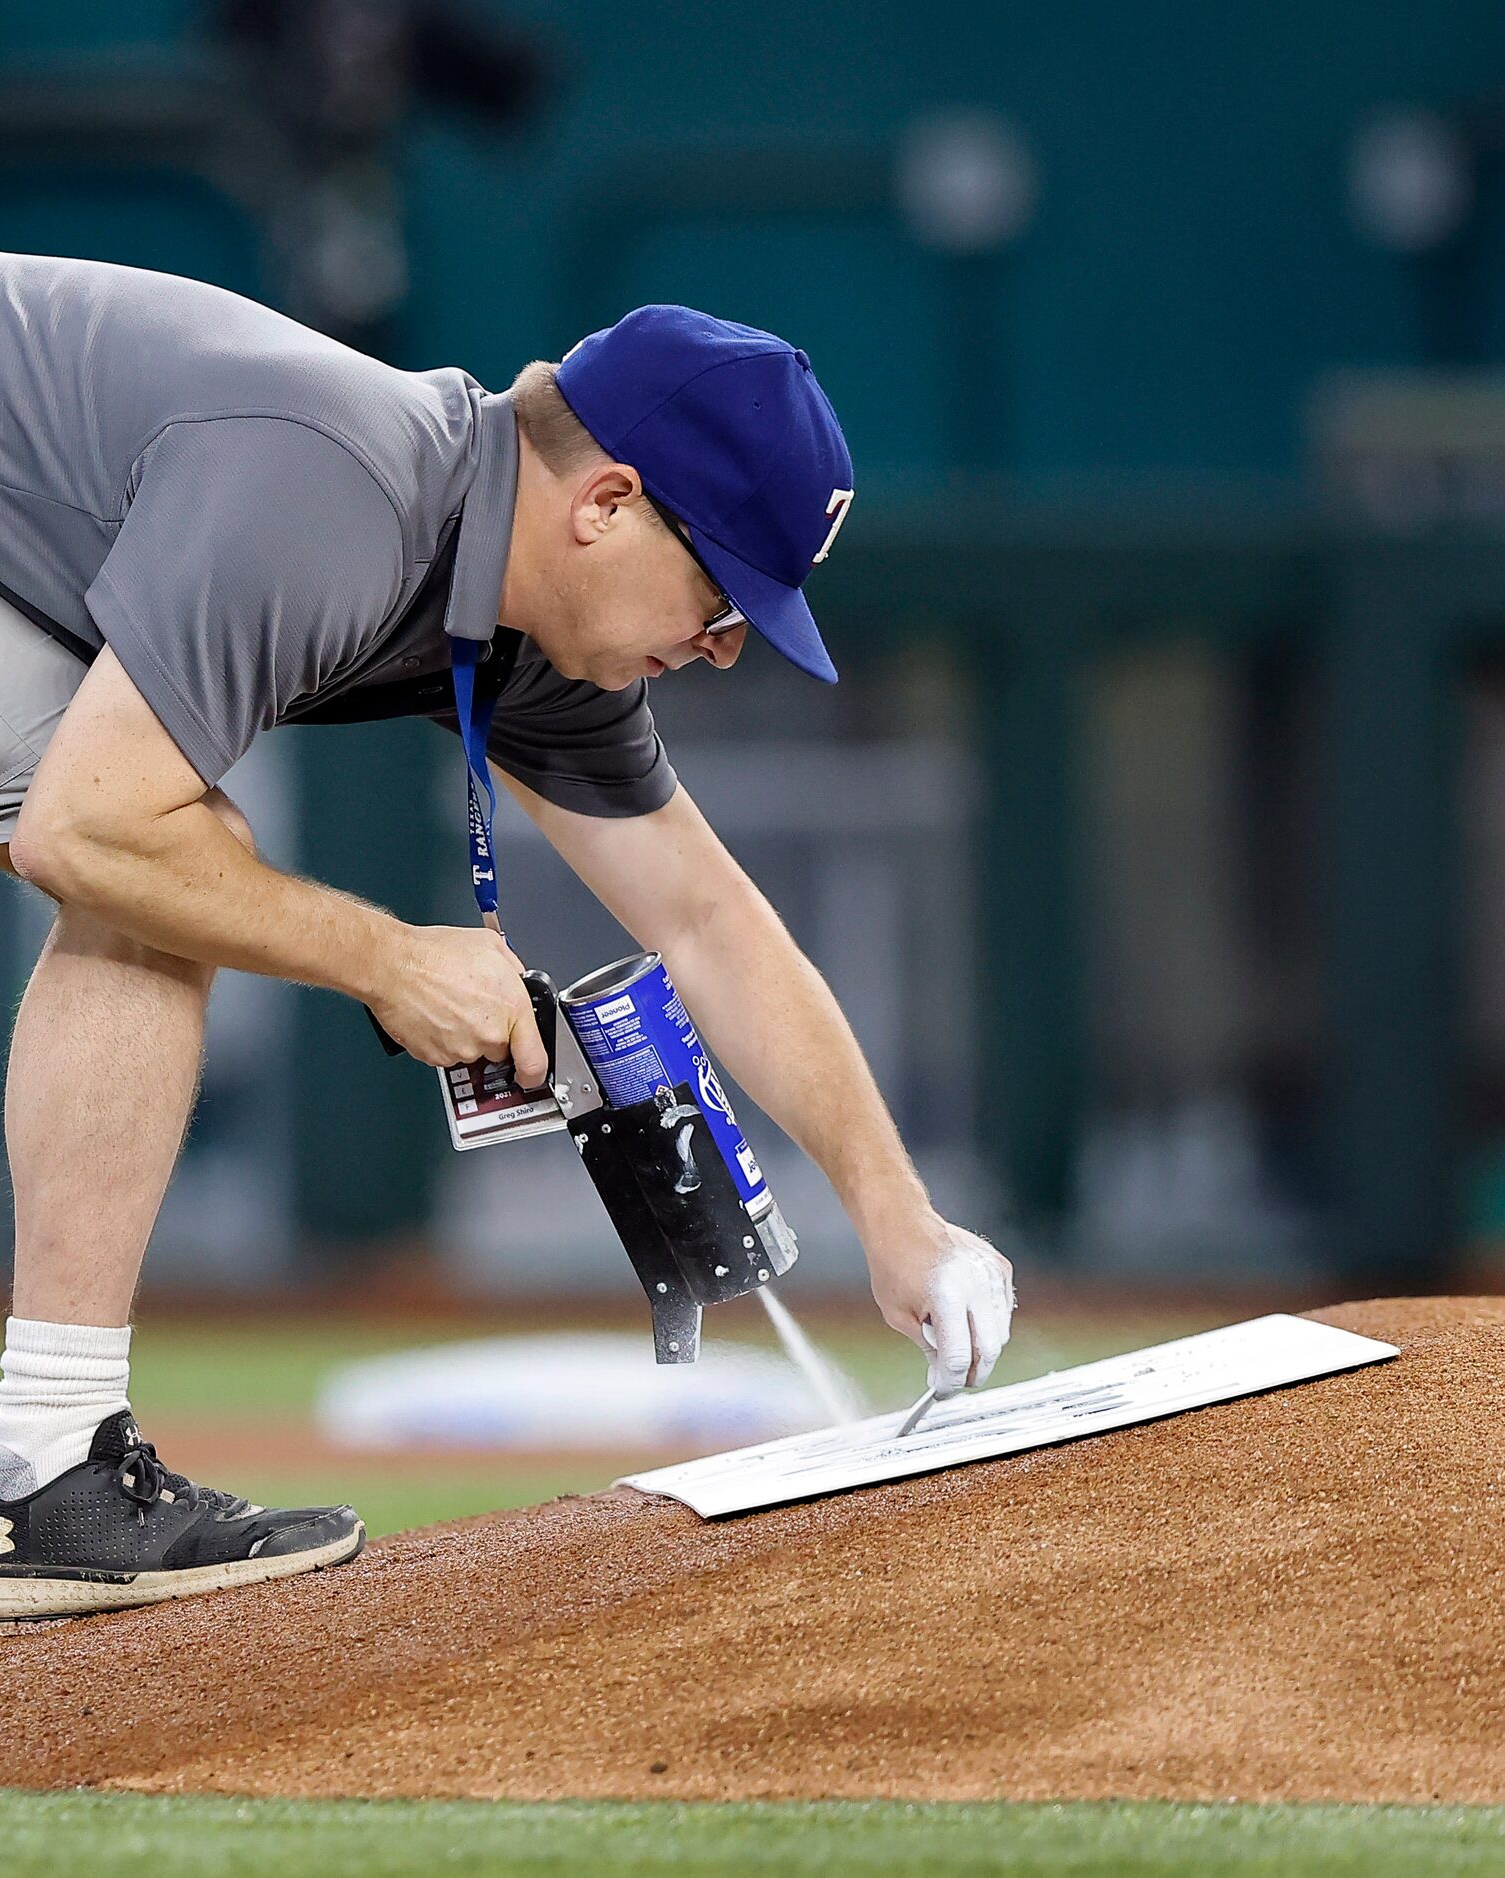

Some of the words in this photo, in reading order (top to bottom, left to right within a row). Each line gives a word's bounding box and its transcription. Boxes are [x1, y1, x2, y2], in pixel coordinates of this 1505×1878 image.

[811, 488, 855, 564] T
[473, 865, 494, 885] T
[498, 1111, 515, 1120] Greg
